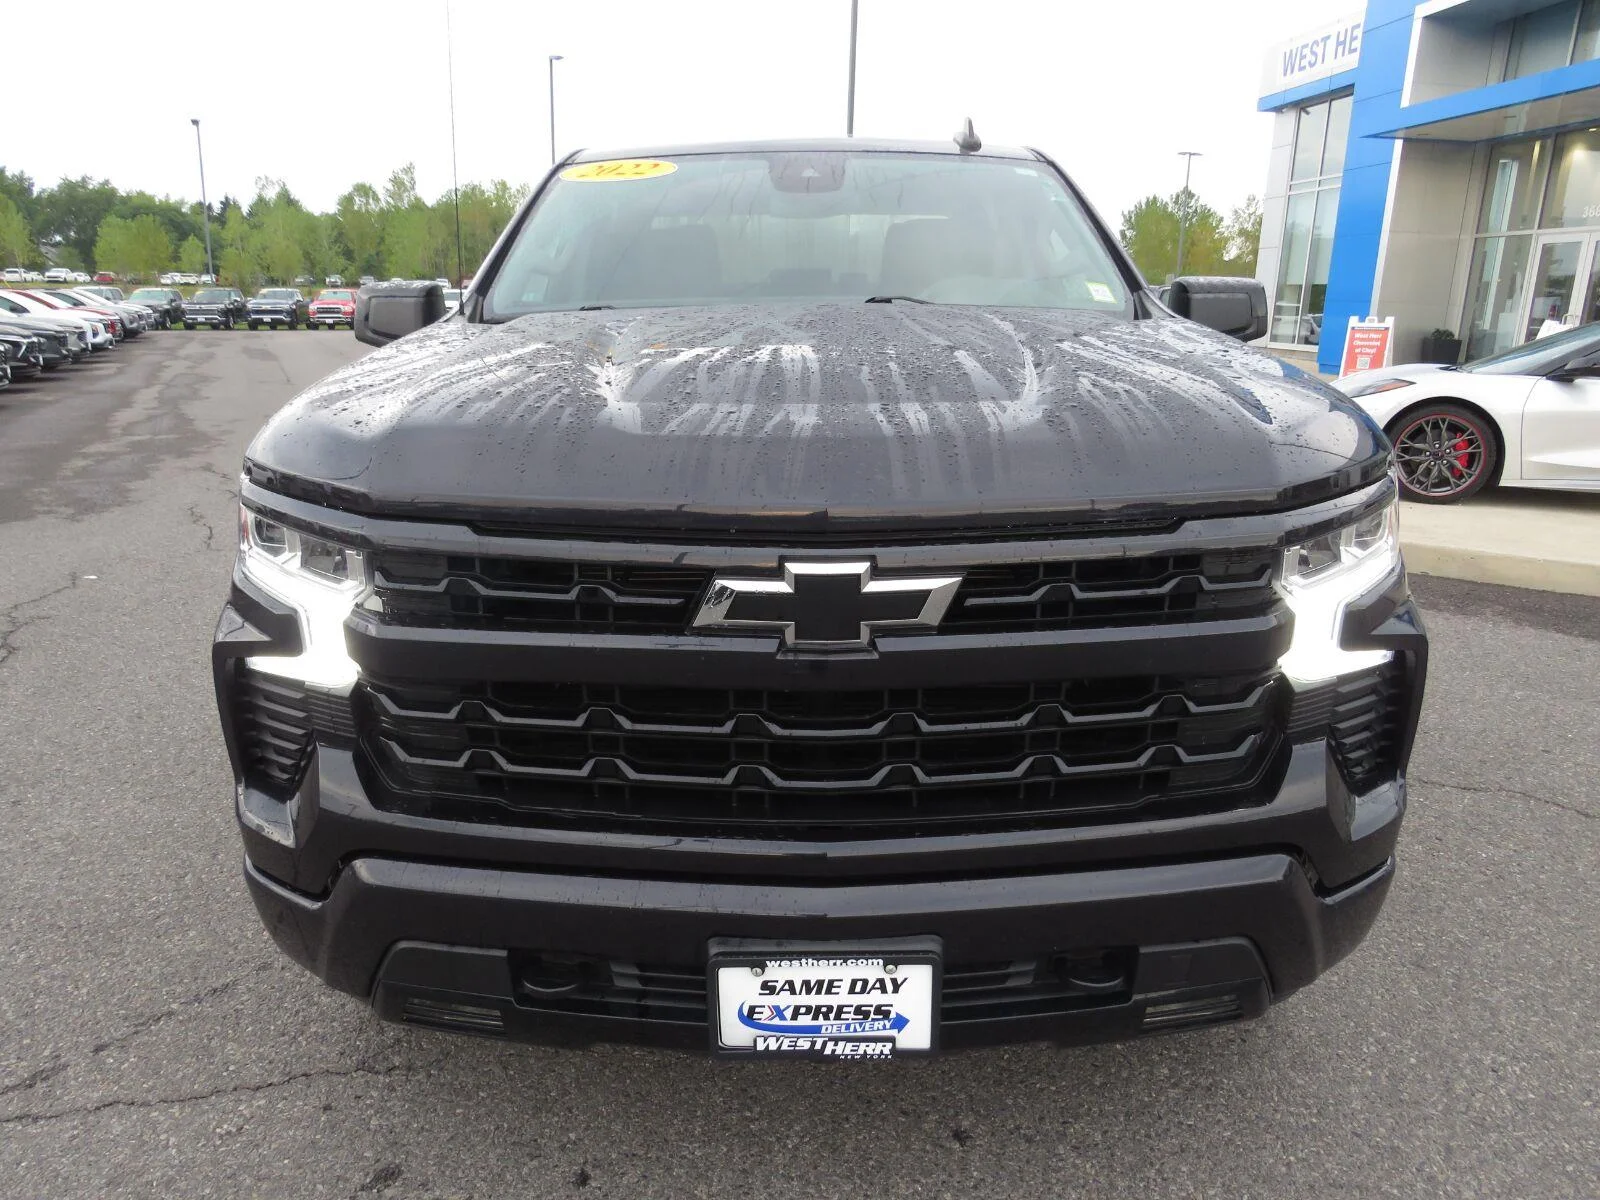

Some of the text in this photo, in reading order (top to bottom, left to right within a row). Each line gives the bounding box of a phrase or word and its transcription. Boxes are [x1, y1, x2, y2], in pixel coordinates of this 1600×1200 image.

[1282, 34, 1331, 77] WEST
[575, 163, 660, 178] 2022
[765, 958, 884, 968] westherr.com
[759, 977, 908, 995] SAME DAY
[747, 1004, 893, 1021] EXPRESS
[821, 1019, 893, 1034] DELIVERY
